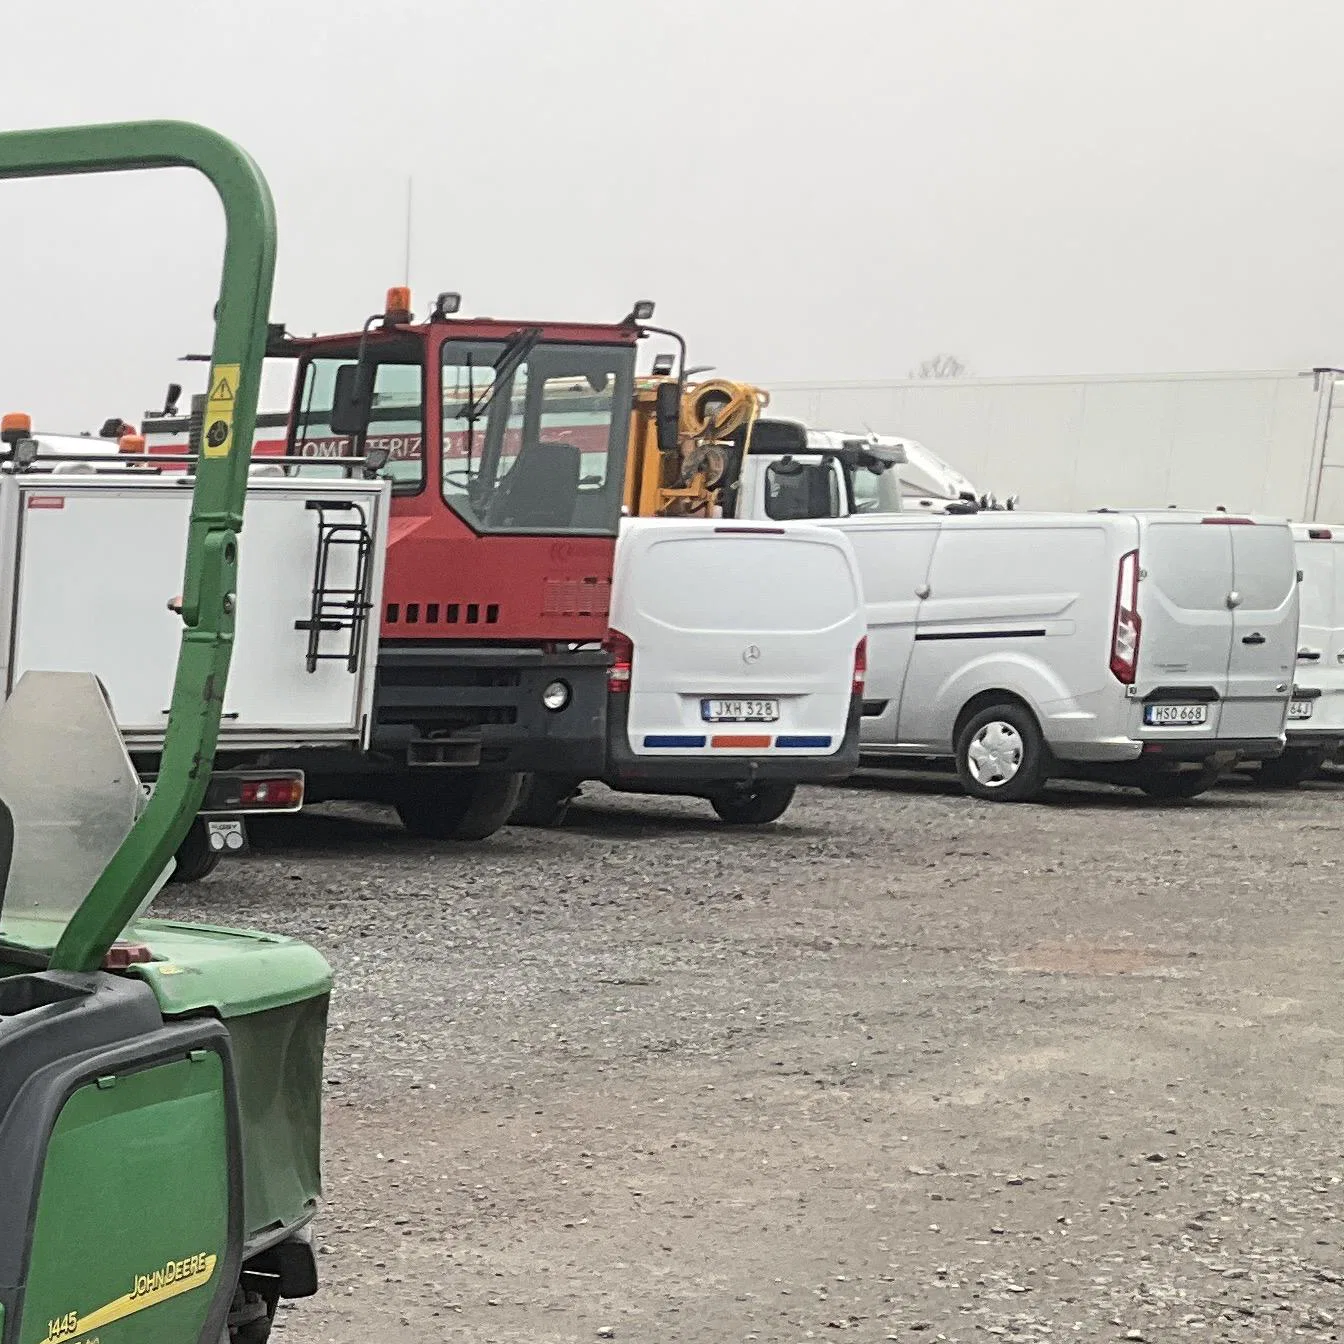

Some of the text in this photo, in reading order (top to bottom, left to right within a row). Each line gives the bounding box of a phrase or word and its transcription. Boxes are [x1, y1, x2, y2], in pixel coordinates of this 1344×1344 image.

[715, 701, 773, 716] JXH 328
[1180, 706, 1202, 720] 668
[129, 1251, 207, 1299] JOHN DEERE
[48, 1311, 78, 1341] 1445
